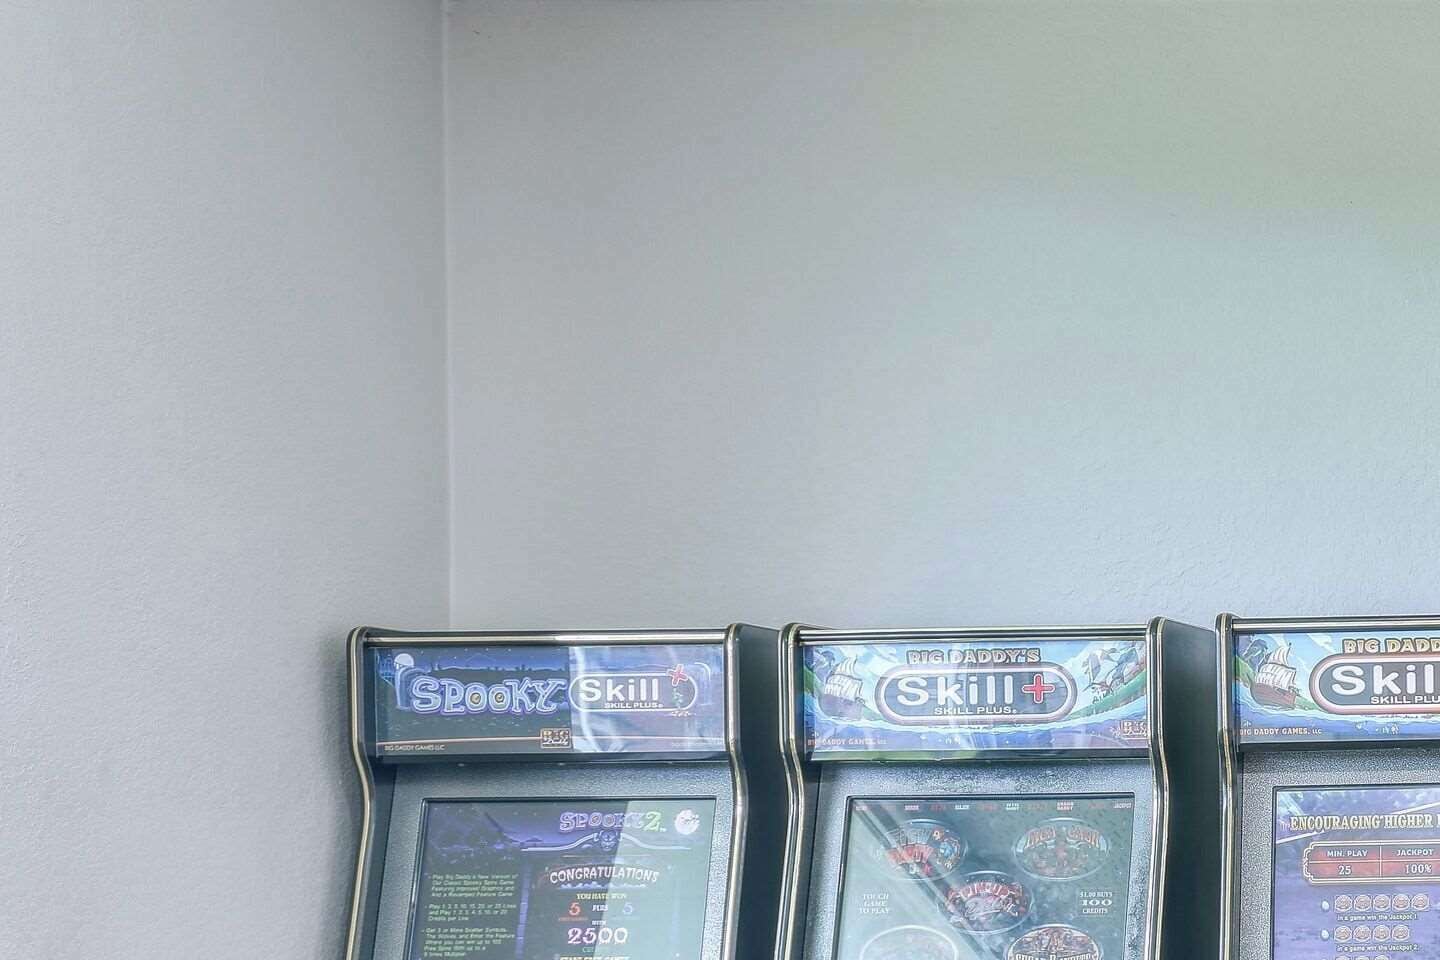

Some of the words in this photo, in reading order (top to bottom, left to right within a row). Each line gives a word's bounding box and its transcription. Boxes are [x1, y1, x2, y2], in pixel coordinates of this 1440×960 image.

[1343, 639, 1378, 654] BIG
[908, 650, 943, 664] BIG
[948, 648, 1041, 664] DADDY'S
[411, 676, 567, 715] SPOOKY
[1370, 696, 1411, 704] SKILL
[604, 701, 631, 709] SKILL
[934, 706, 974, 715] SKILL
[1254, 727, 1280, 735] DADDY
[1290, 815, 1381, 832] ENCOURAGING
[1384, 814, 1435, 829] HIGHER
[1326, 849, 1345, 858] MIN.
[1346, 849, 1369, 858] PLAY
[1396, 848, 1435, 857] JACKPOT
[549, 865, 659, 884] CONGRATULATIONS
[1338, 865, 1352, 876] 25
[1404, 864, 1433, 875] 100%
[567, 927, 629, 944] 2500
